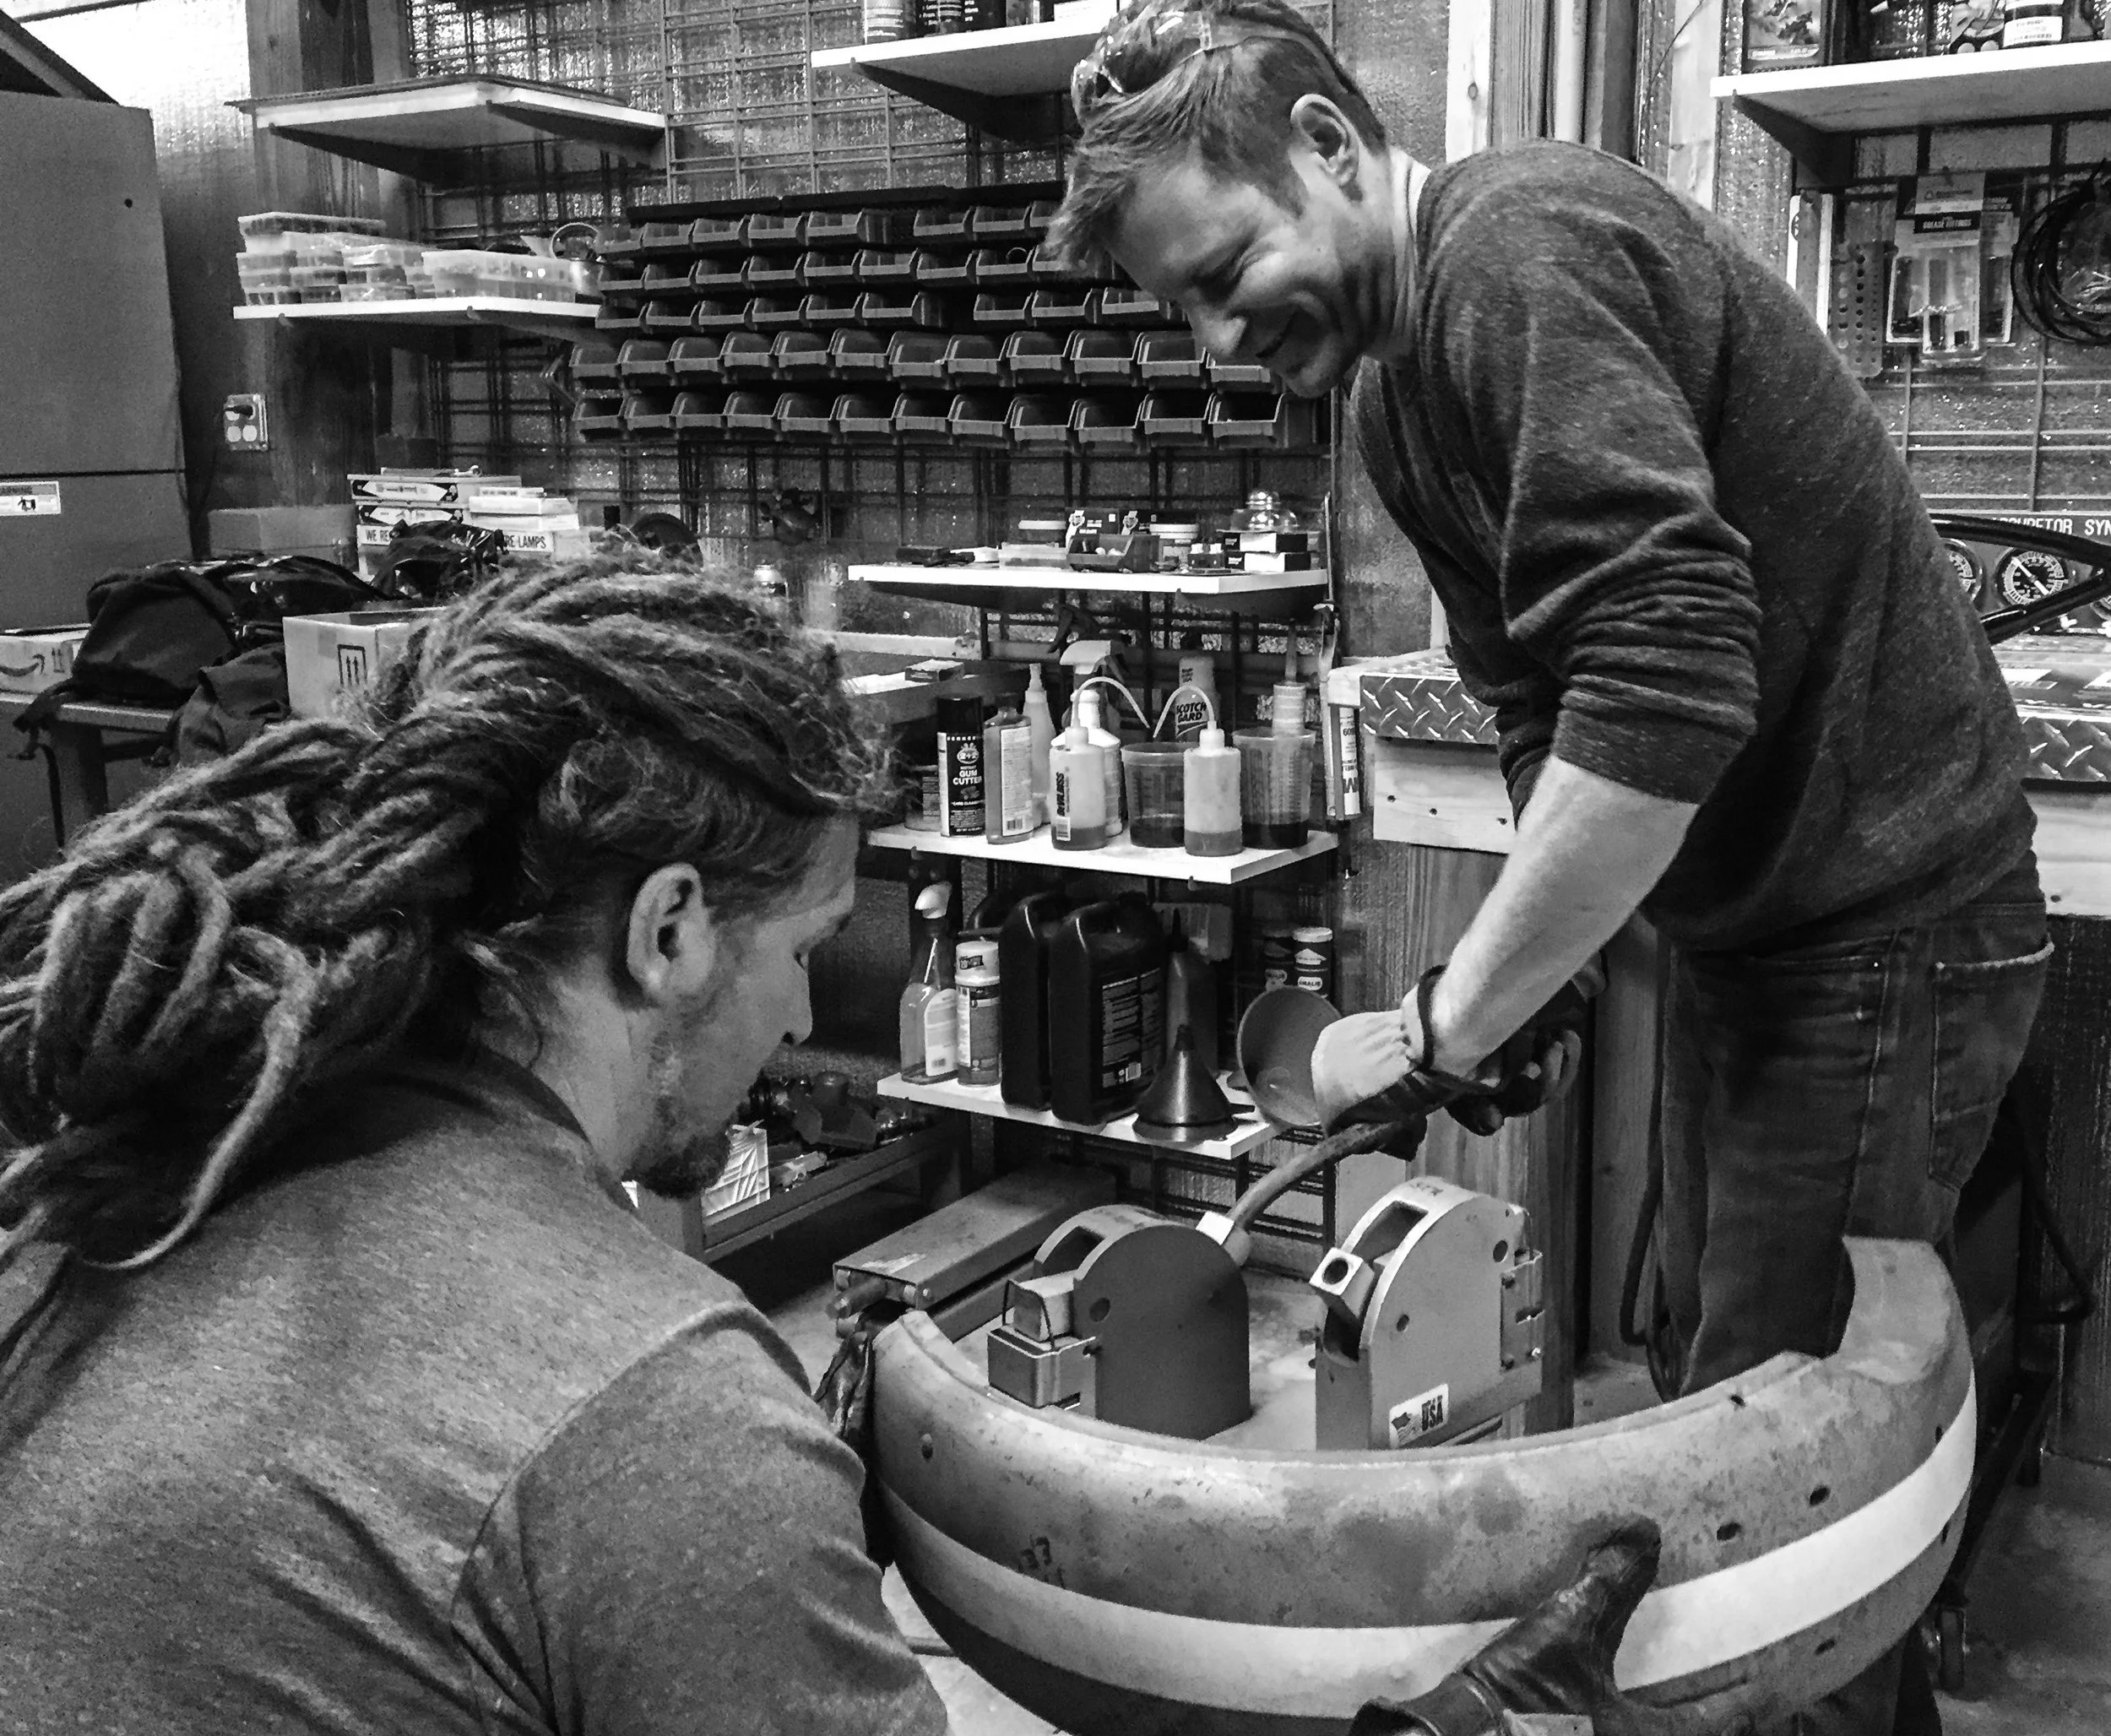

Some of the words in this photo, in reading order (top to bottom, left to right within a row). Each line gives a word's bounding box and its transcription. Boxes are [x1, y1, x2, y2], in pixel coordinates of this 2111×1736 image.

[518, 535, 546, 549] LAMPS
[958, 769, 978, 778] GUM
[1421, 1395, 1443, 1432] USA
